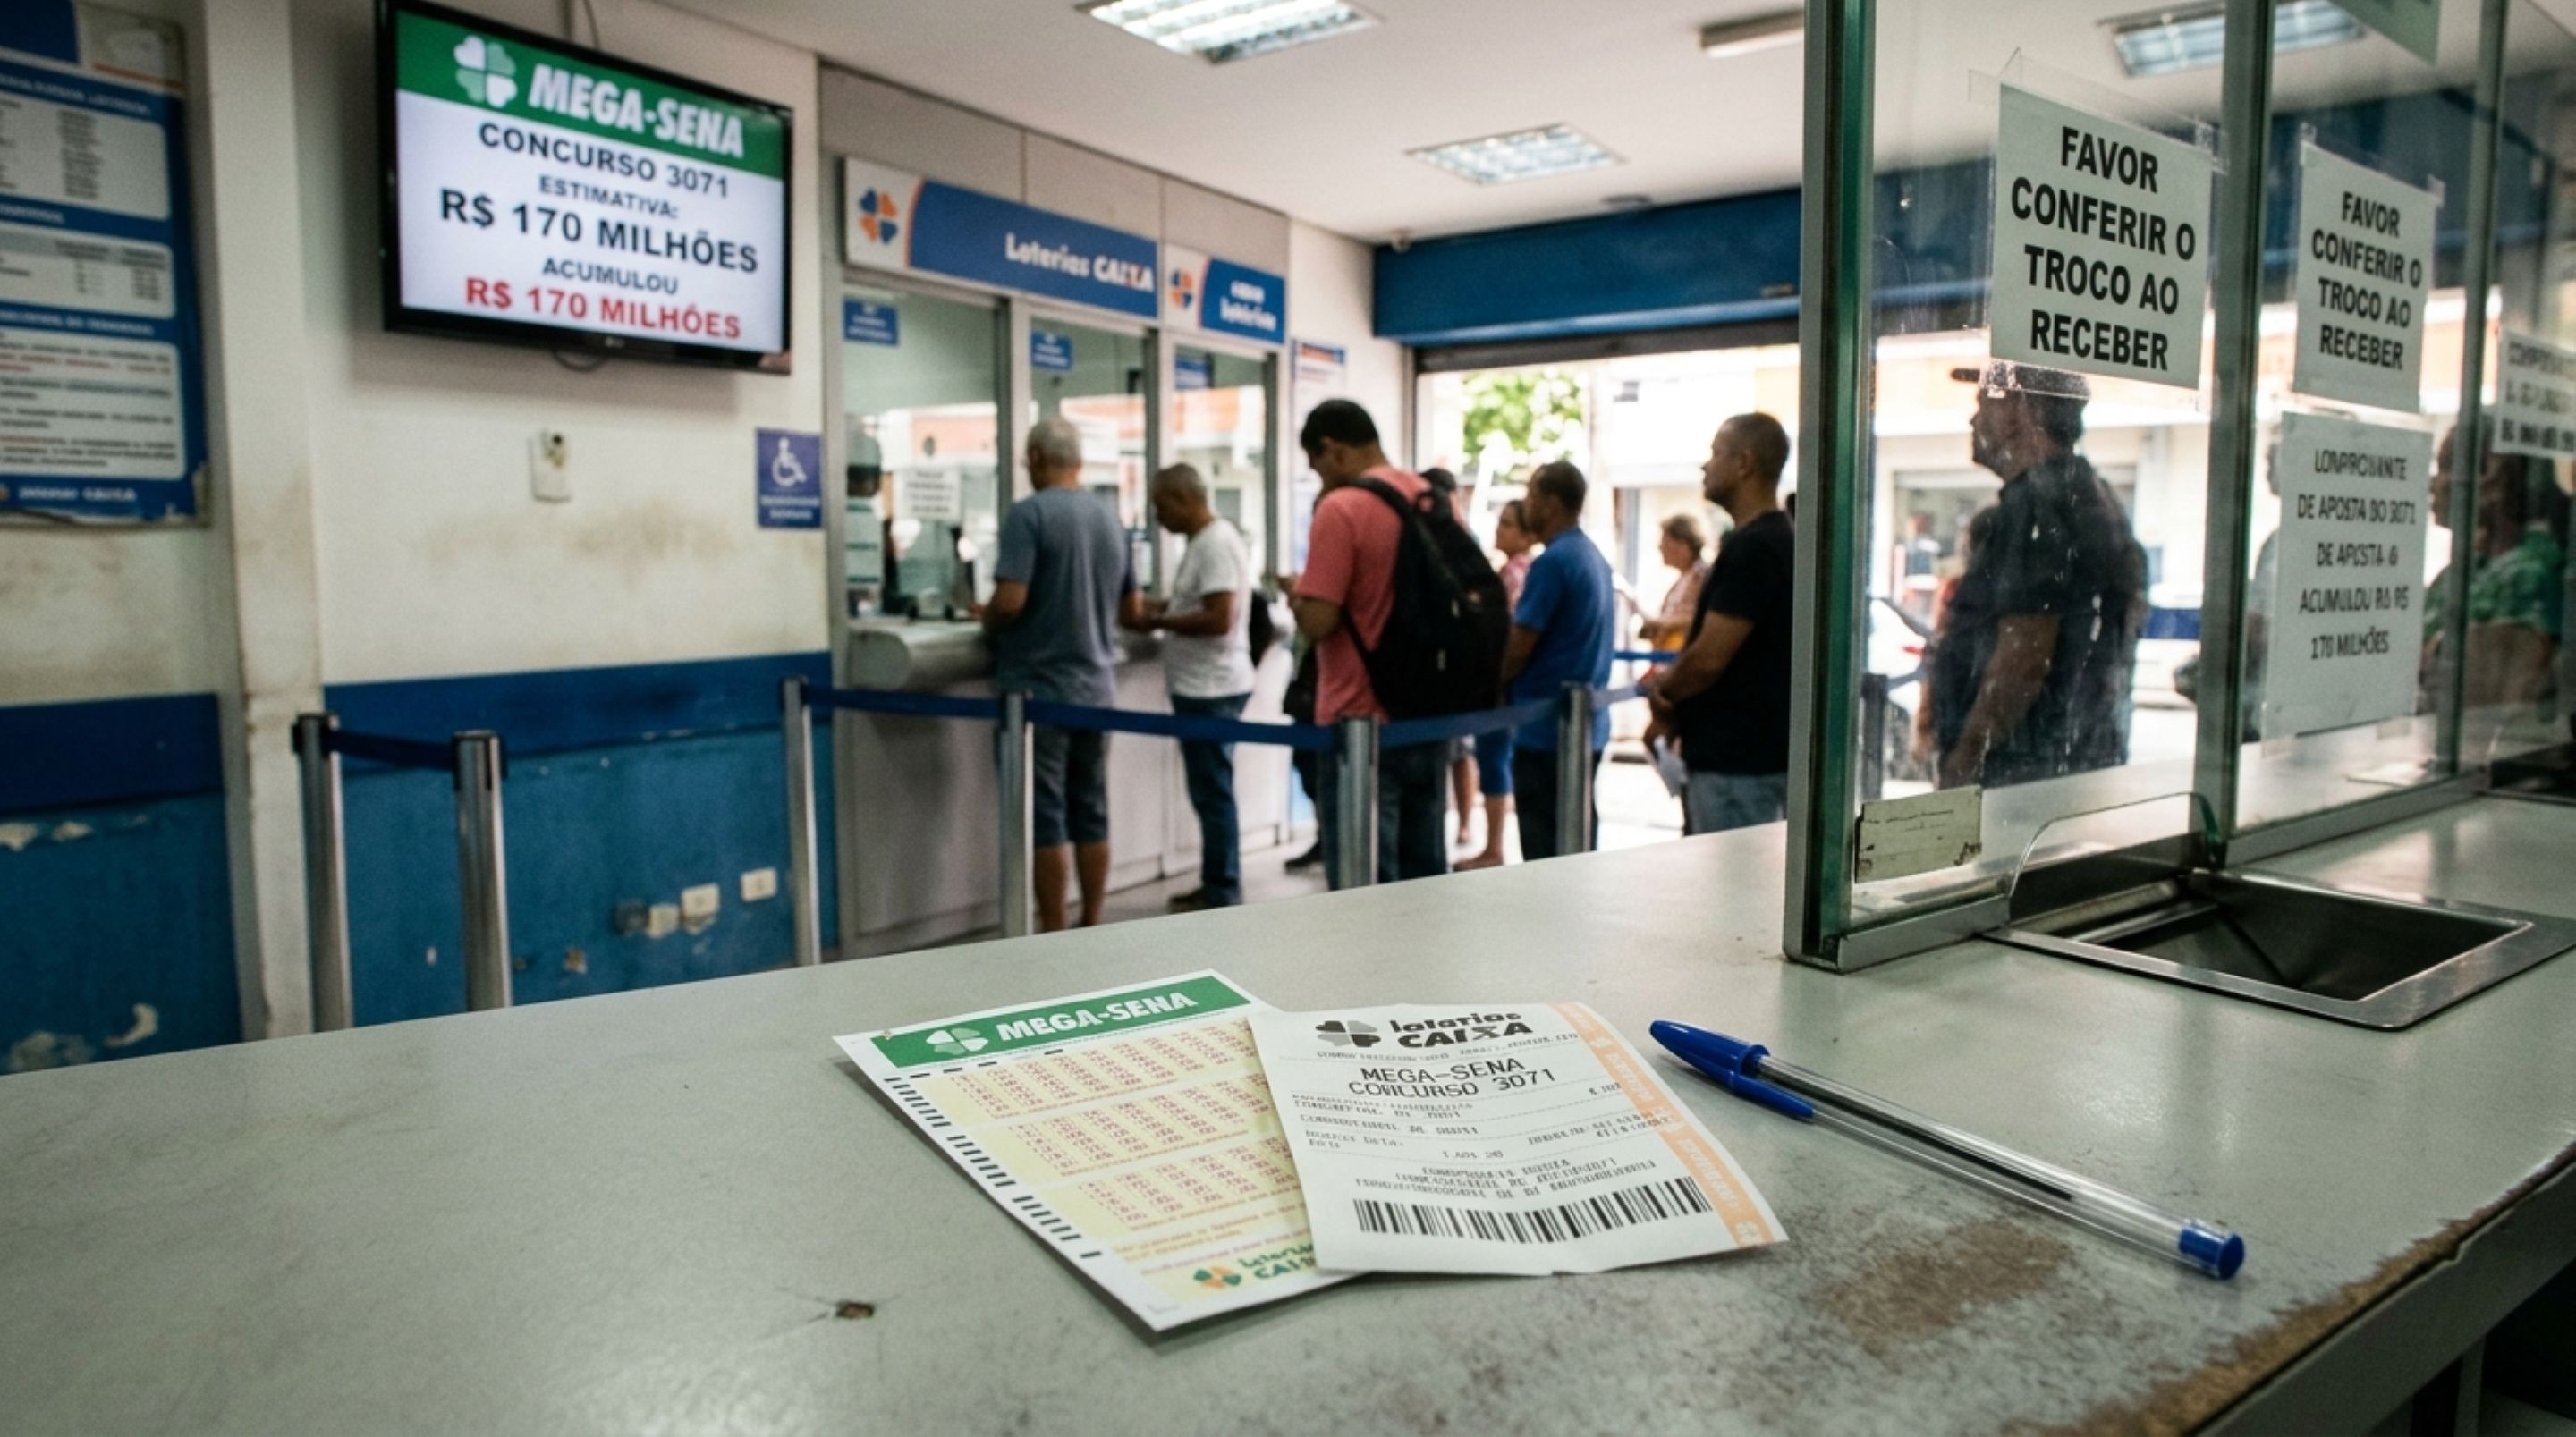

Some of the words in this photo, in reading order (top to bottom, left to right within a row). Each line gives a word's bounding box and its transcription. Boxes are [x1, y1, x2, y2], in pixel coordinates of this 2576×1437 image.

[479, 123, 657, 182] CONCURSO
[666, 164, 729, 198] 3071
[2061, 125, 2158, 193] FAVOR
[539, 175, 679, 219] ESTIMATIVA:
[2011, 177, 2166, 256] CONFERIR
[2175, 223, 2195, 260] O
[2342, 190, 2400, 238] FAVOR
[439, 189, 495, 227] R$
[513, 203, 582, 242] 170
[597, 219, 758, 274] MILHÕES
[542, 258, 679, 295] ACUMULOU
[2024, 244, 2131, 304] TROCO
[2139, 272, 2179, 315] AO
[2311, 228, 2405, 286] CONFERIR
[2410, 258, 2422, 289] O
[465, 277, 513, 309] R$
[526, 286, 588, 319] 170
[2318, 276, 2382, 322] TROCO
[2385, 296, 2411, 329] AO
[2030, 309, 2168, 371] RECEBER
[2319, 324, 2403, 371] RECEBER
[2298, 494, 2315, 519] DE
[2316, 542, 2334, 567] DE
[1398, 1022, 1533, 1048] CAIXA
[1360, 1057, 1526, 1084] MEGA-SENA
[1492, 1069, 1555, 1092] 3071
